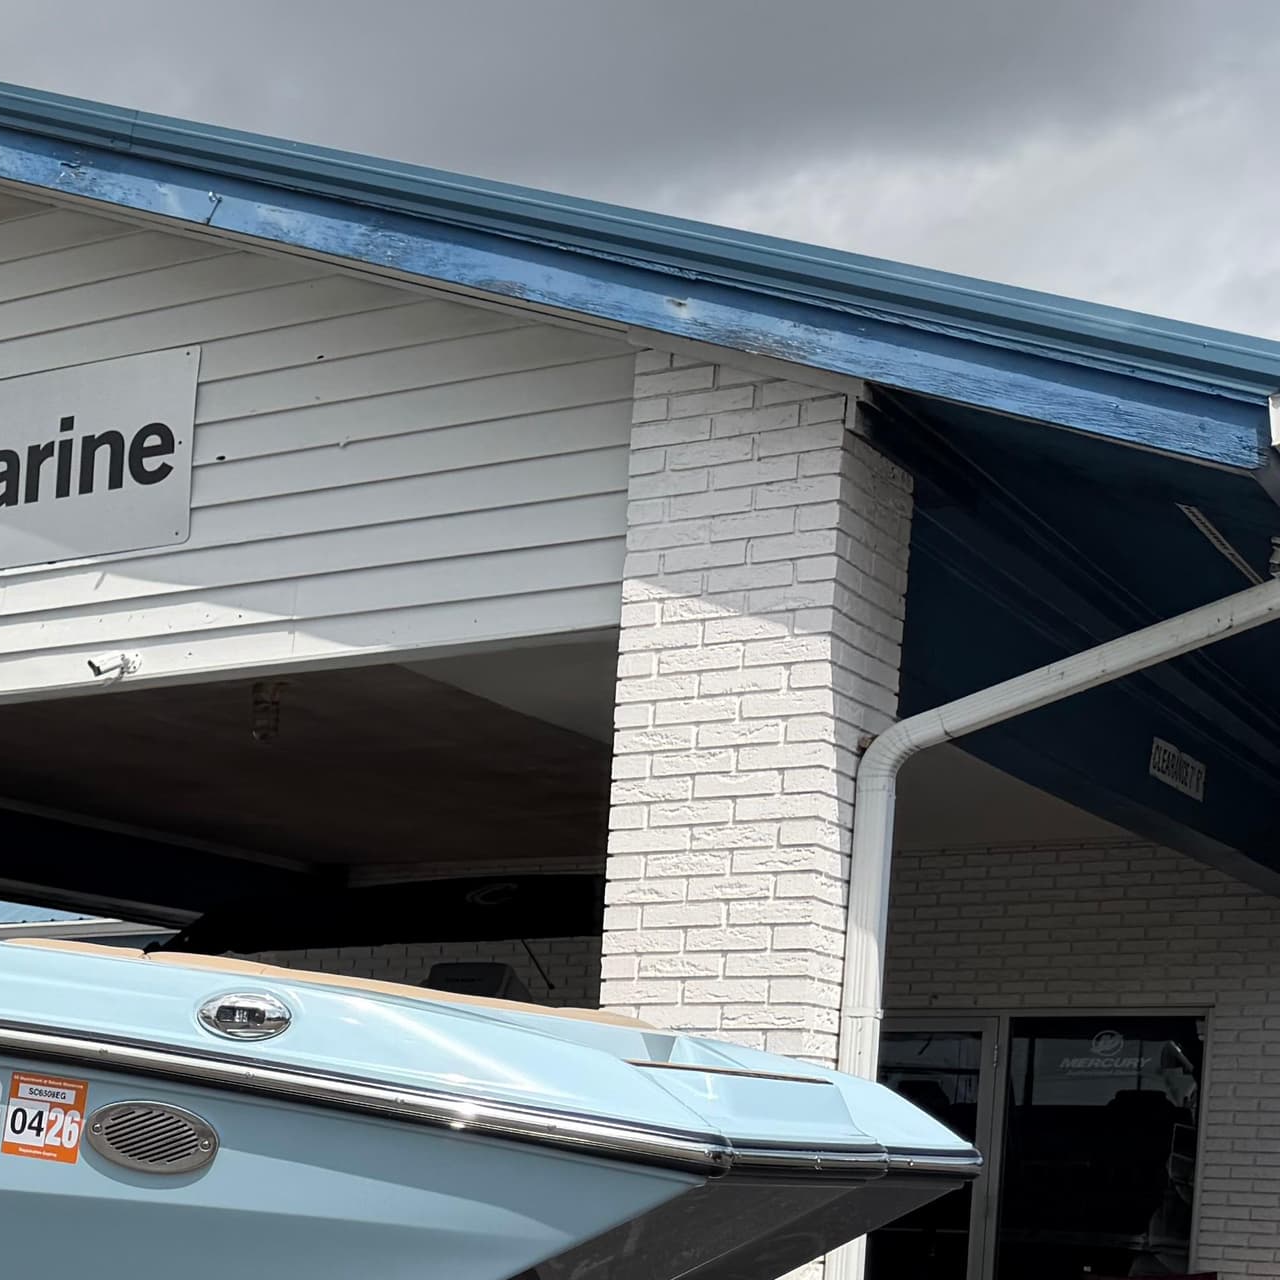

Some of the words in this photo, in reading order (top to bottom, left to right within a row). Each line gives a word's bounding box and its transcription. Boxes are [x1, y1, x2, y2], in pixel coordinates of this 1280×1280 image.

[1059, 1057, 1152, 1068] MERCURY
[10, 1107, 44, 1137] 04
[45, 1107, 81, 1149] 26
